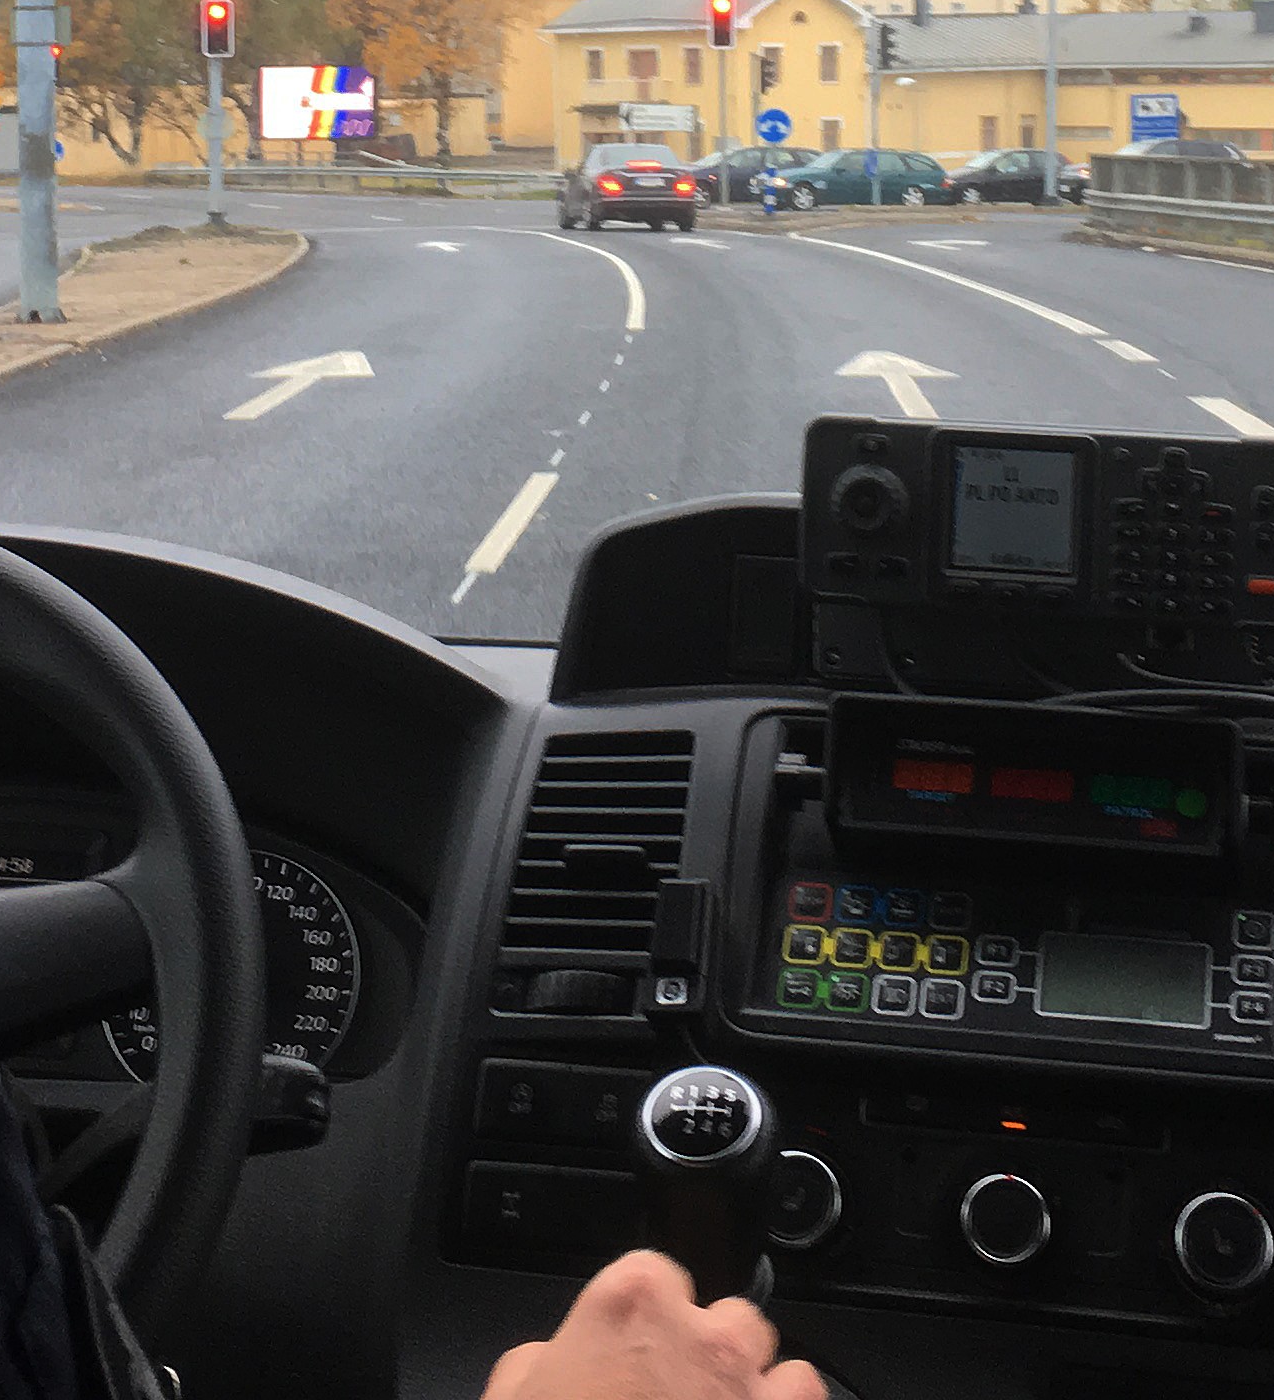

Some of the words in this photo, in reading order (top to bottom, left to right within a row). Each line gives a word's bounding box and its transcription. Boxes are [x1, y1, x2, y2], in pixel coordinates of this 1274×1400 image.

[267, 884, 295, 901] 120
[287, 904, 318, 921] 140
[302, 928, 333, 946] 160
[309, 956, 340, 973] 180
[305, 984, 339, 1001] 200
[293, 1013, 327, 1031] 220
[670, 1085, 685, 1100] R
[688, 1084, 699, 1099] 1
[705, 1084, 721, 1100] 3
[723, 1087, 737, 1102] 5
[681, 1117, 696, 1135] 2
